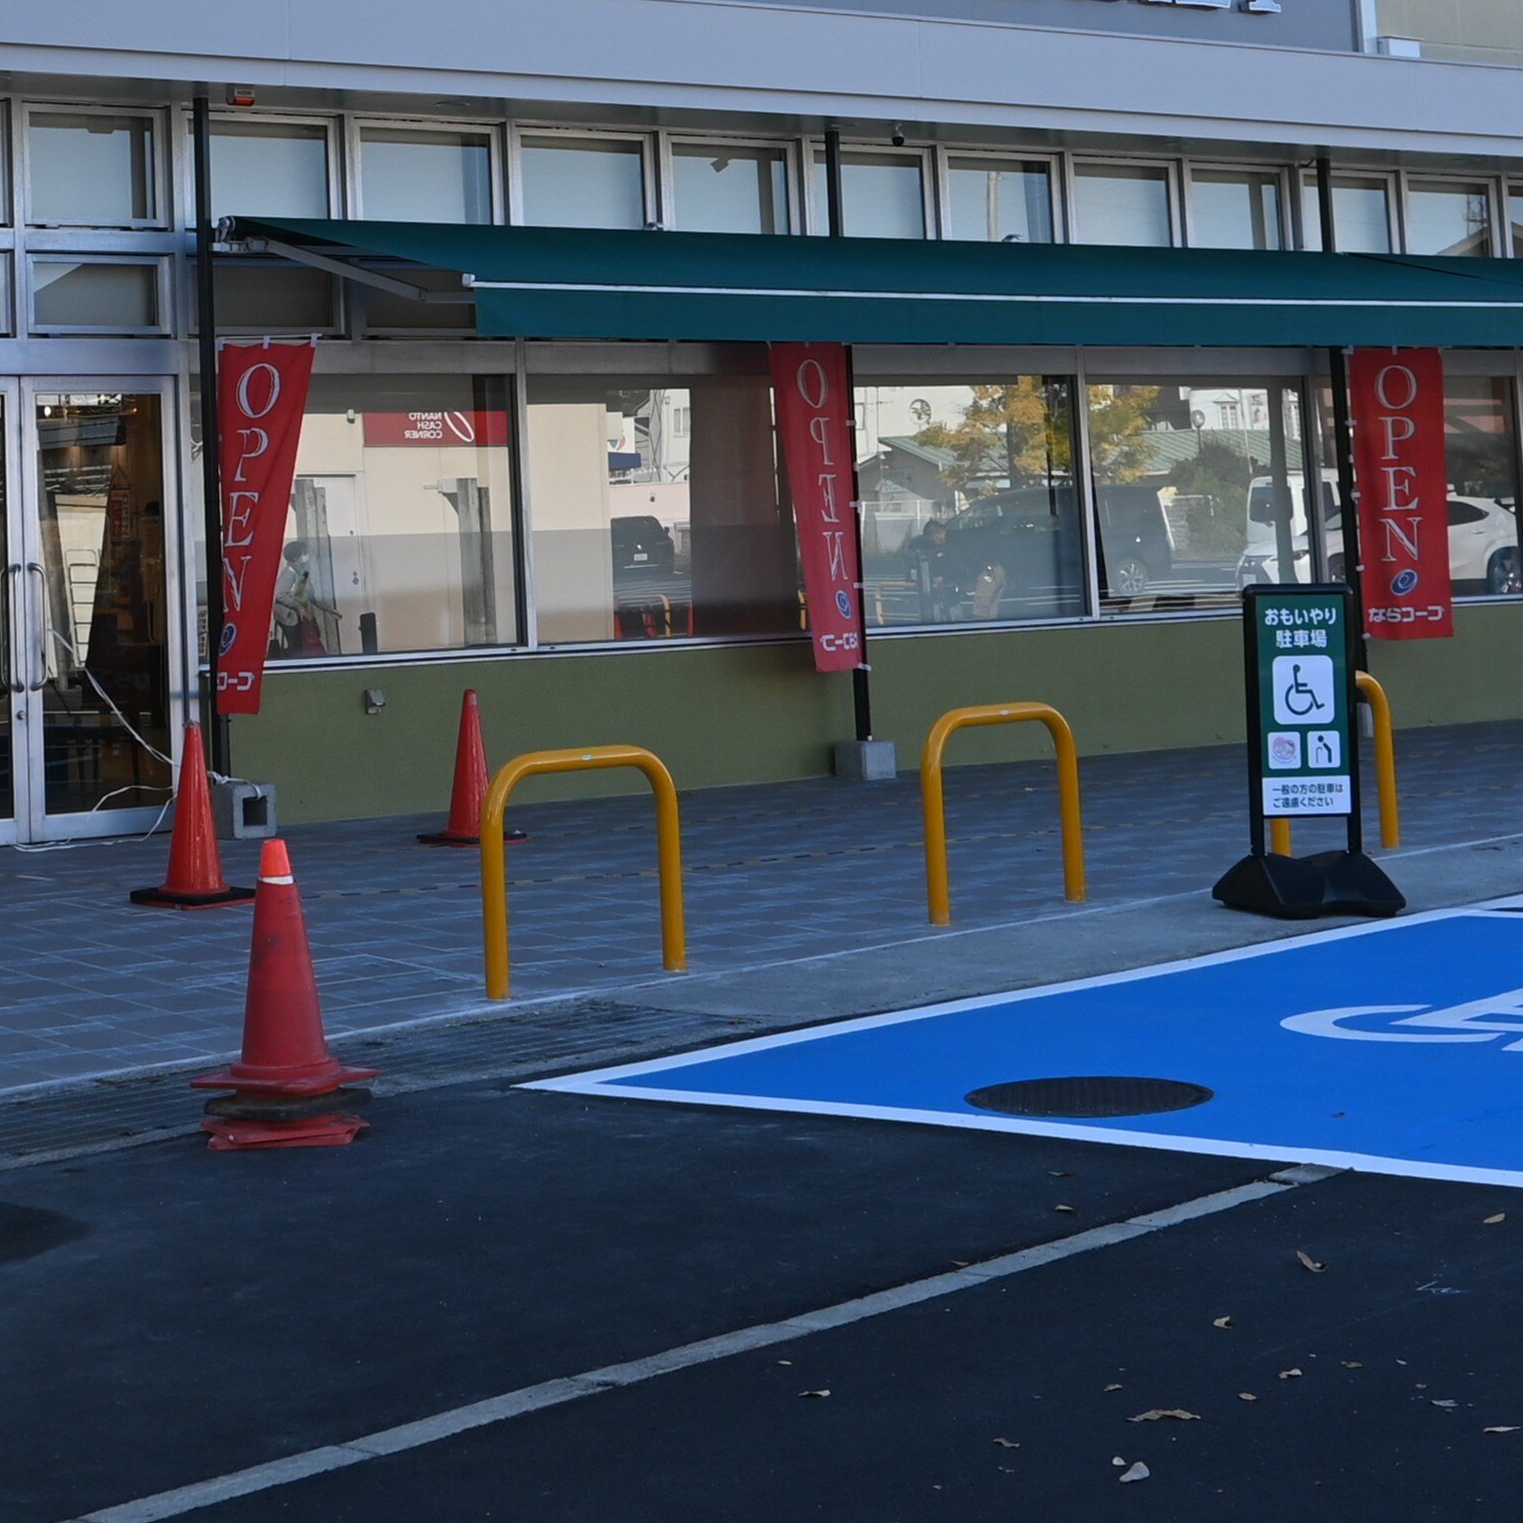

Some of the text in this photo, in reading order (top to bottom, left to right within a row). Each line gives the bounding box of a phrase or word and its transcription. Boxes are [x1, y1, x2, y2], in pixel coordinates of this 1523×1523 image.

[1375, 365, 1423, 562] OPEN
[223, 362, 281, 613] OPEN
[1264, 607, 1336, 625] おもいやり
[1368, 606, 1445, 623] ならコープ
[1276, 629, 1327, 648] 駐車場
[1272, 783, 1343, 795] 一般の方の駐車は
[1273, 796, 1334, 808] ご遠慮ください
